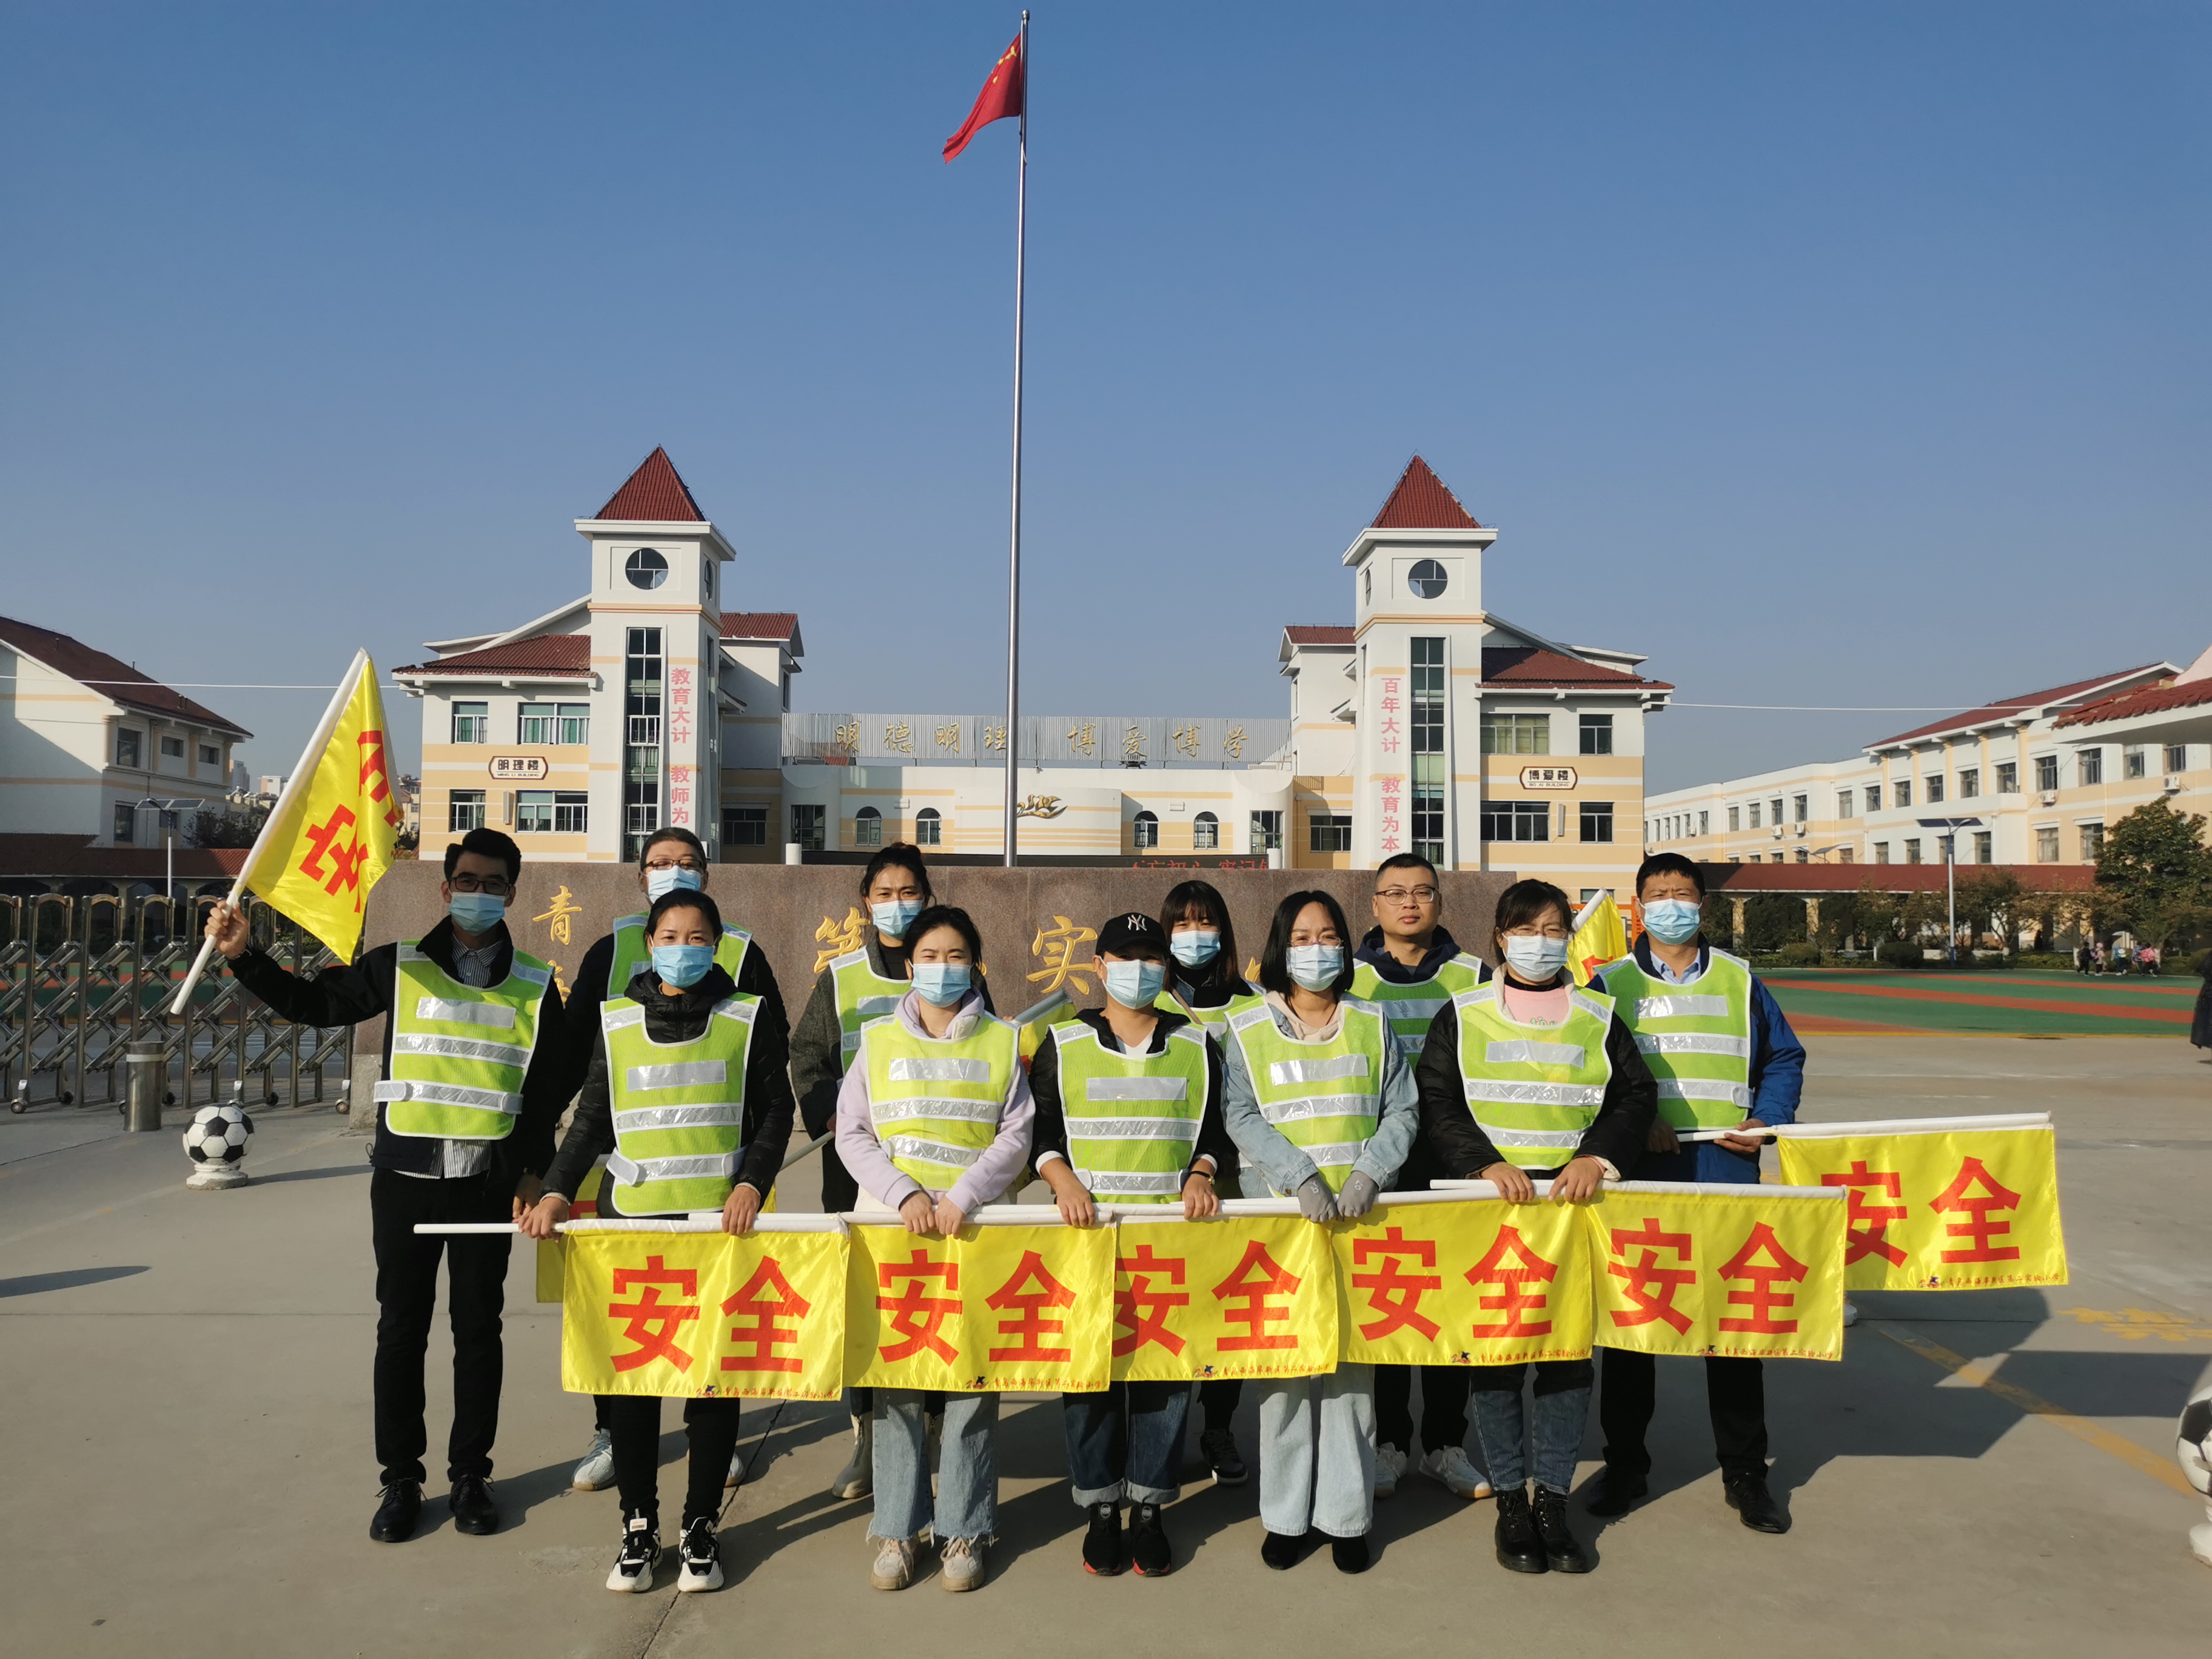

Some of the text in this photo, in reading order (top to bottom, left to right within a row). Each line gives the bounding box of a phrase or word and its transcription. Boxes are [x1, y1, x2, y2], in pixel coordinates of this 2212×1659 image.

[497, 759, 539, 771] 明理楼
[670, 668, 691, 824] 教育大计 教师为
[1067, 723, 1248, 759] 博爱博学
[1381, 677, 1401, 853] 百年大计 教育为本
[1528, 769, 1569, 781] 博爱楼
[1127, 914, 1147, 931] NY
[1821, 1156, 2022, 1268] 安全
[609, 1255, 812, 1374] 安全
[876, 1248, 1077, 1366] 安全
[1112, 1240, 1302, 1358] 安全
[1352, 1224, 1559, 1342] 安全
[1607, 1218, 1809, 1336] 安全
